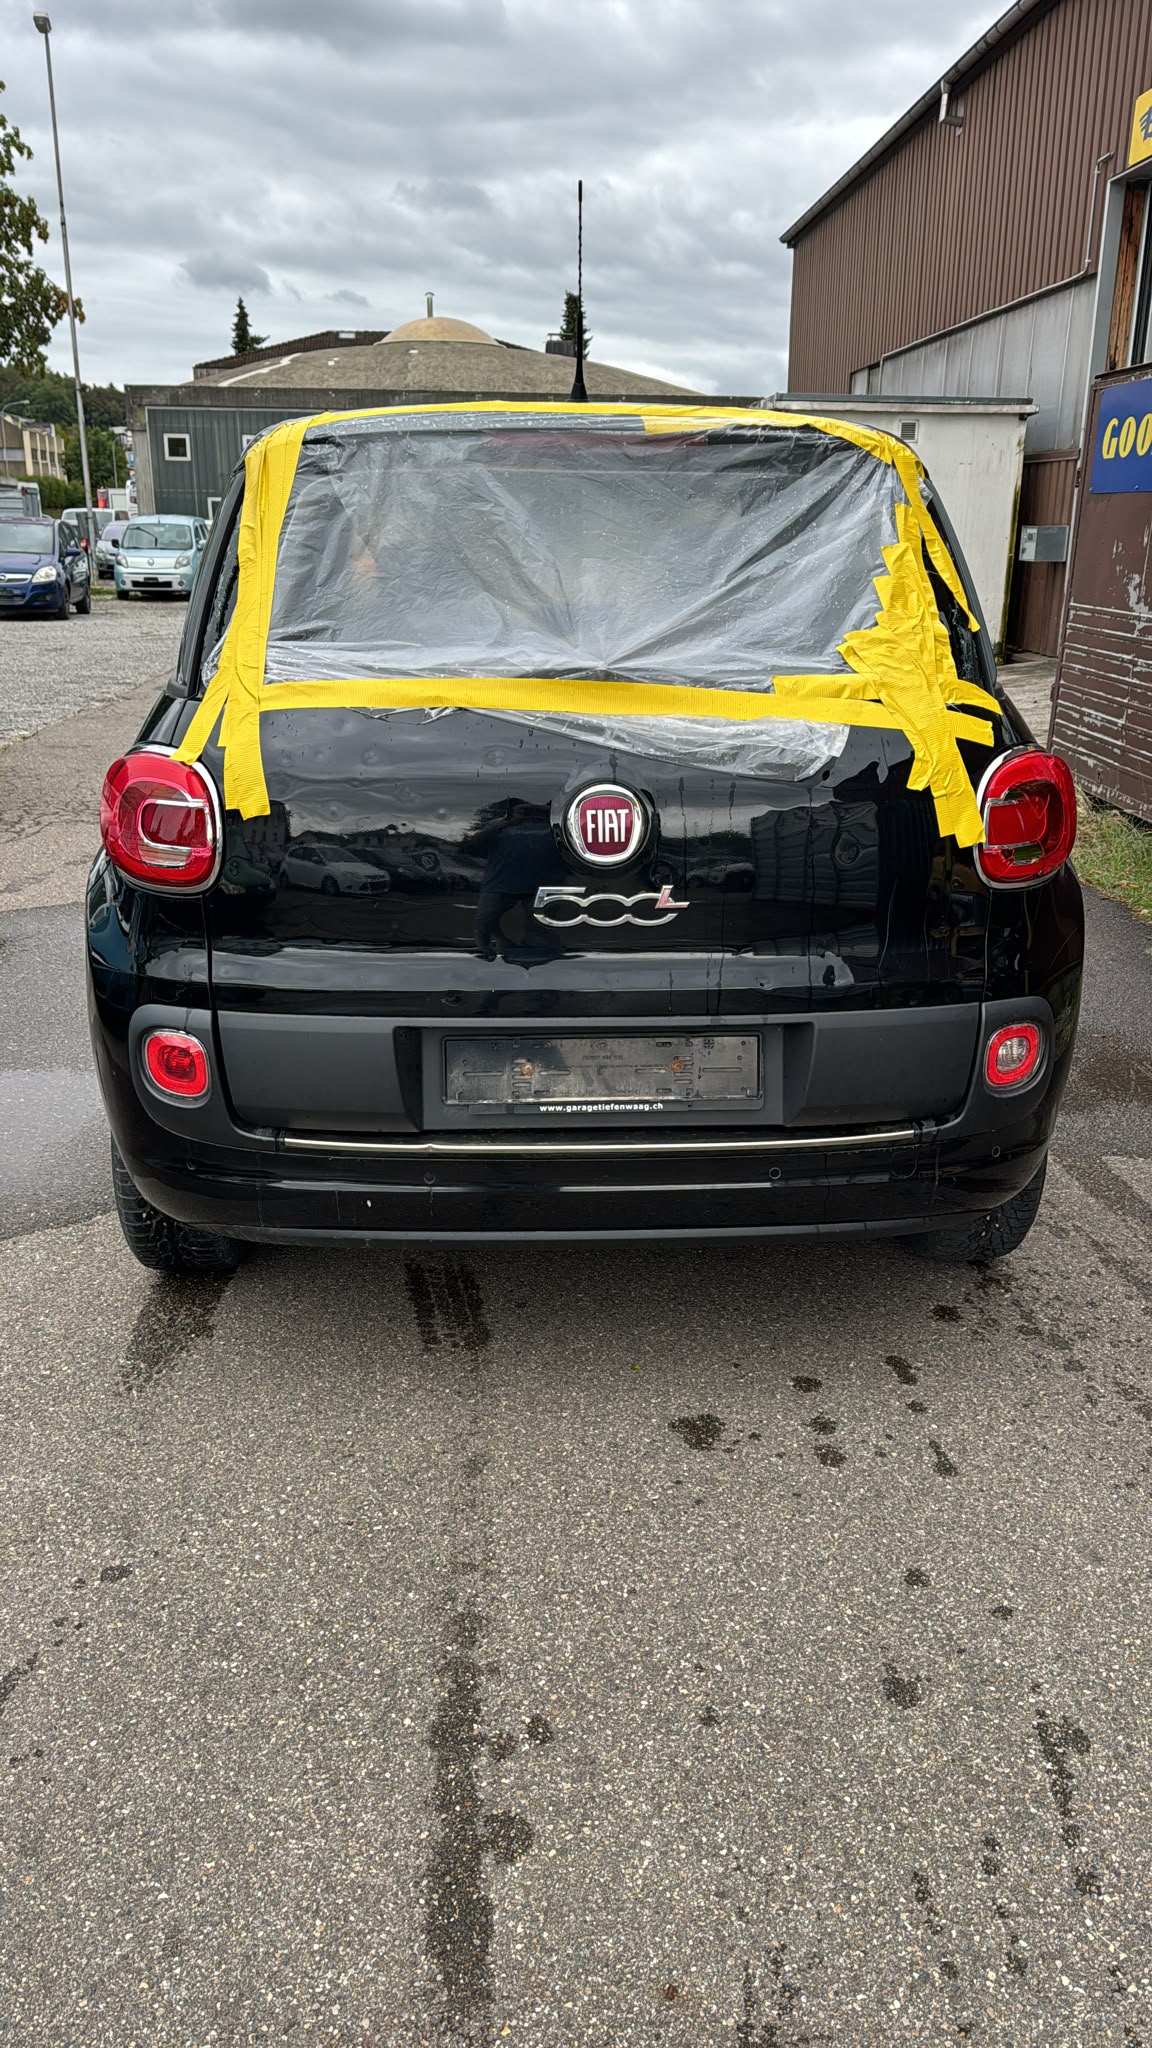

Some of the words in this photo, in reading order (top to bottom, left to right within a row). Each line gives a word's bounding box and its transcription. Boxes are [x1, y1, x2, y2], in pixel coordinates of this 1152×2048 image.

[1103, 413, 1152, 460] GOO
[586, 809, 629, 843] FIAT
[533, 884, 690, 927] 500L
[539, 1103, 663, 1112] www.garagetiefenwaag.ch
